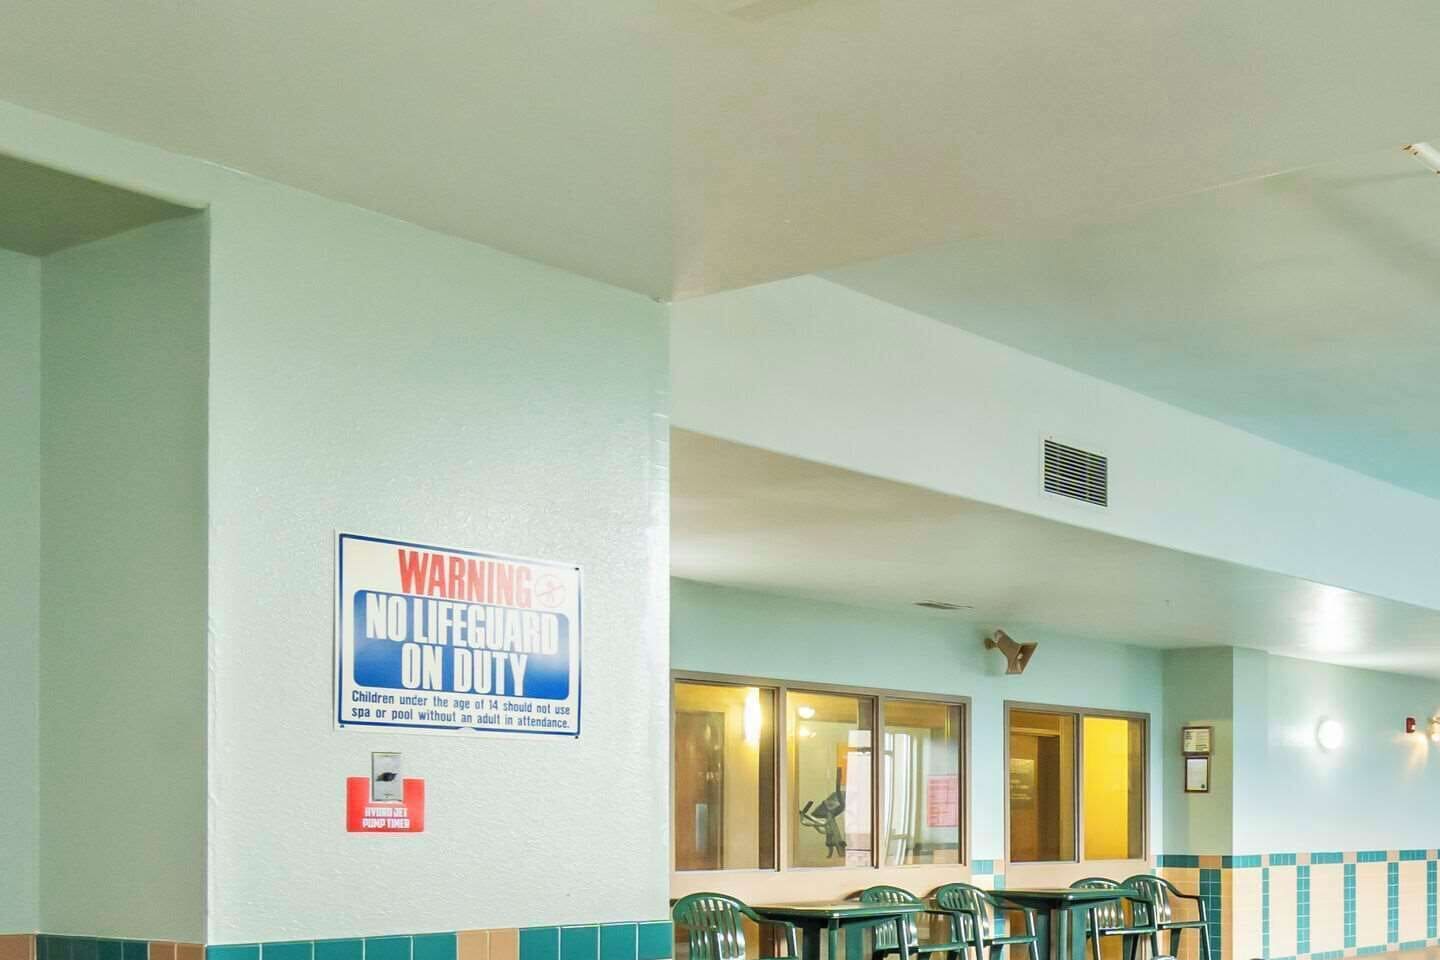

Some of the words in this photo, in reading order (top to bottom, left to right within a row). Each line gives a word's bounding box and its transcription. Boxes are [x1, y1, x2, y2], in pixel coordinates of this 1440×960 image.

[398, 549, 532, 608] WARNING
[366, 592, 407, 642] NO
[413, 598, 560, 655] LIFEGUARD
[401, 643, 443, 691] ON
[454, 648, 528, 697] DUTY
[352, 690, 394, 704] Children
[400, 695, 428, 706] under
[433, 696, 448, 708] the
[453, 699, 470, 710] age
[475, 699, 484, 710] of
[489, 699, 498, 710] 14
[503, 701, 532, 713] should
[537, 703, 551, 713] not
[555, 706, 570, 715] use
[352, 707, 370, 719] spa
[376, 709, 387, 718] or
[392, 709, 413, 720] pool
[418, 710, 456, 722] without
[461, 714, 472, 723] an
[477, 713, 500, 724] adult
[505, 715, 513, 725] in
[518, 716, 569, 729] attendance.
[362, 818, 386, 828] PUMP
